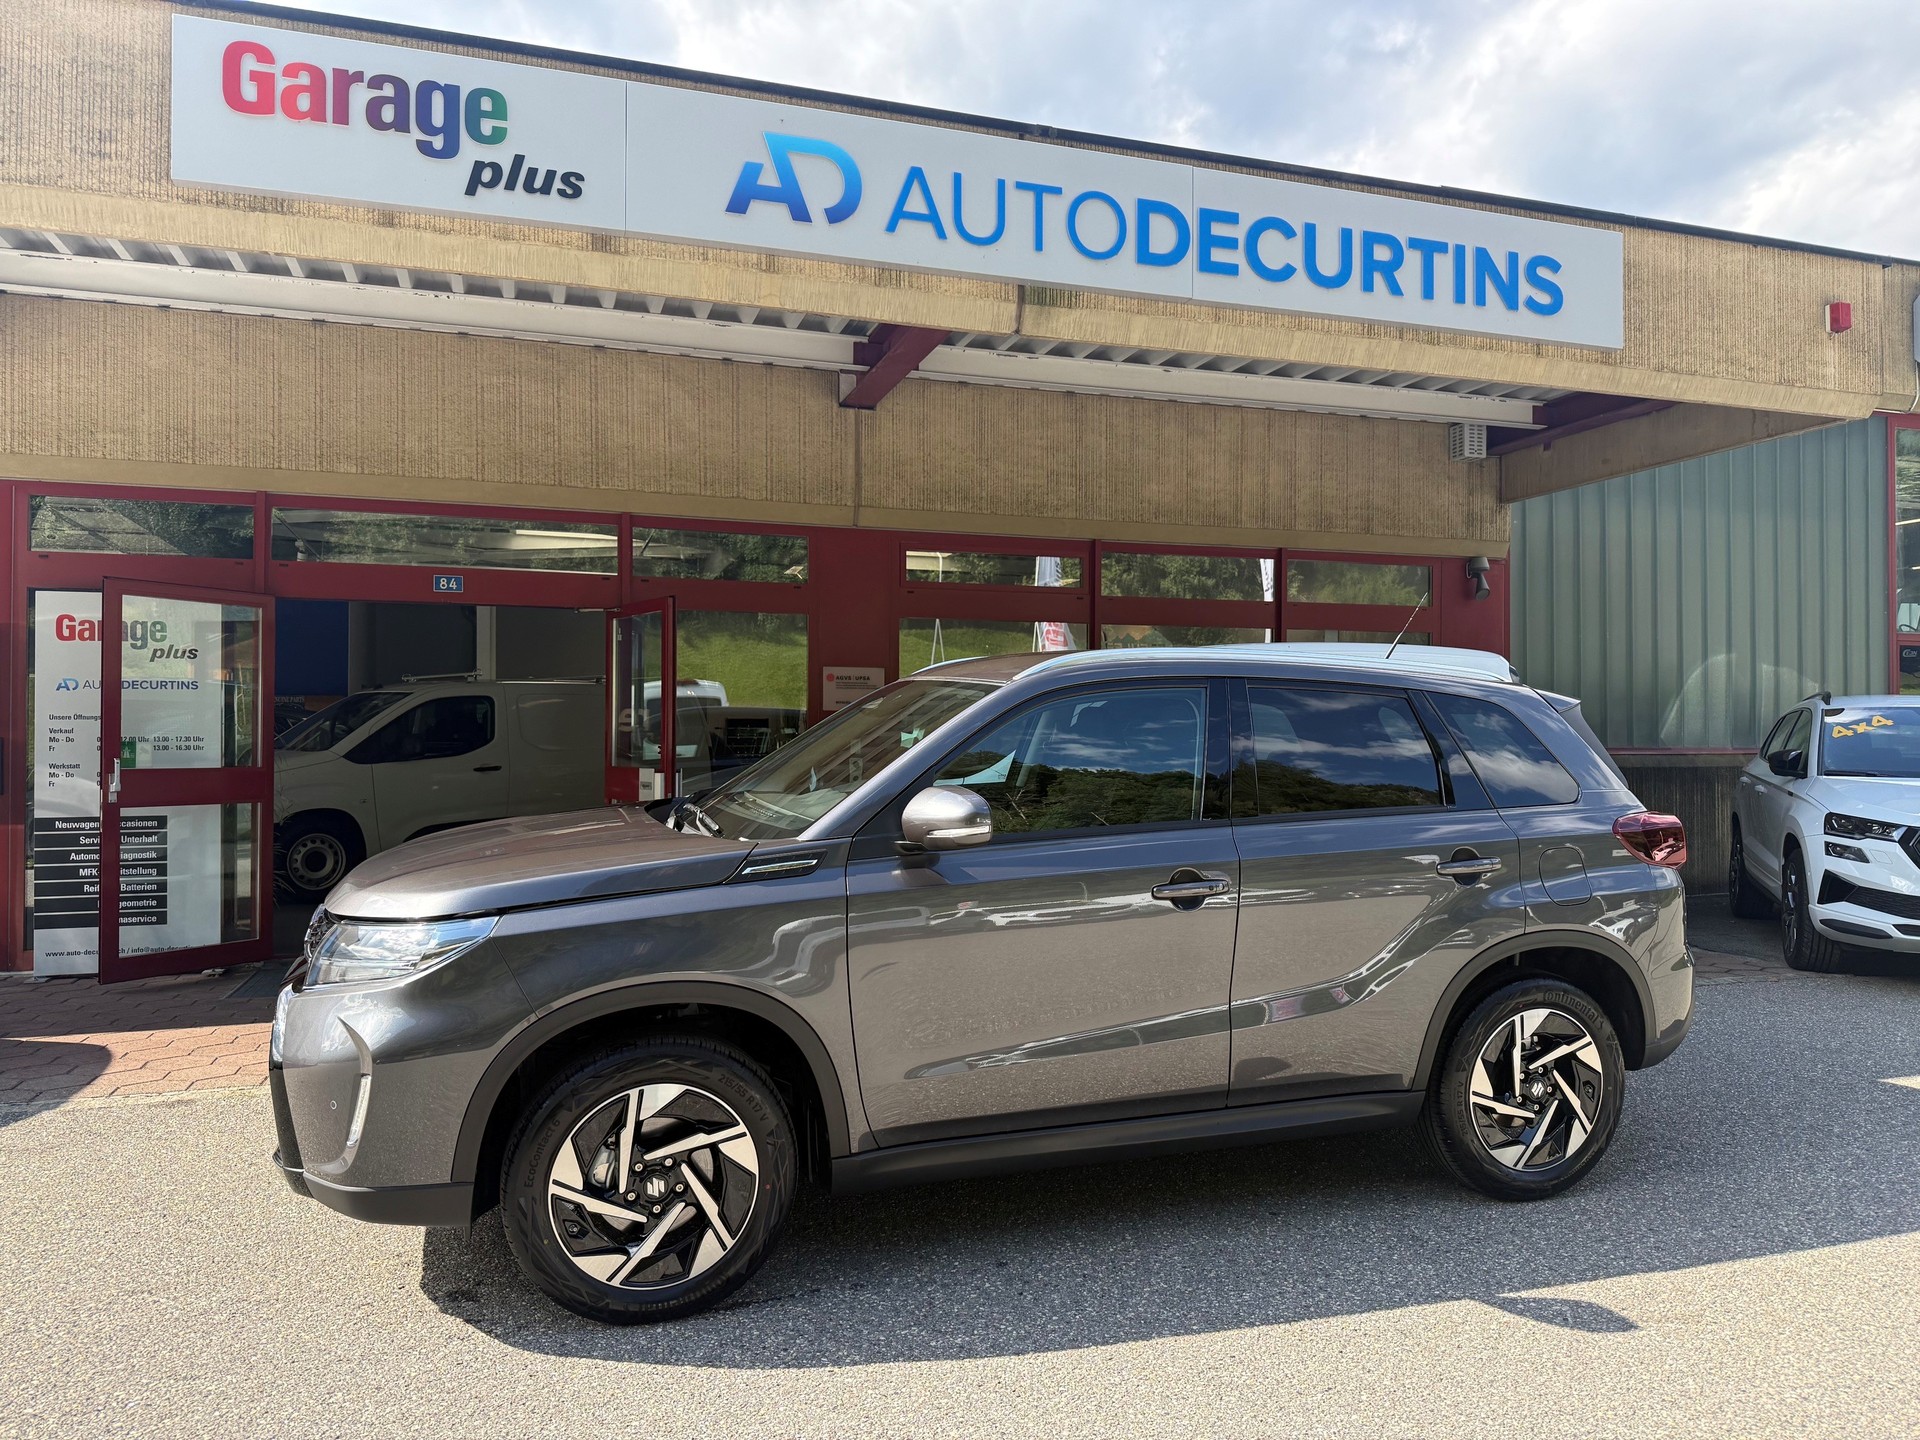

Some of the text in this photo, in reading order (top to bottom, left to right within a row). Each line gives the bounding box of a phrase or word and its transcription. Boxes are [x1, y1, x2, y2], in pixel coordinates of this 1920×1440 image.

[222, 41, 508, 160] Garage
[464, 154, 585, 199] plus
[885, 166, 1564, 316] AUTODECURTINS
[440, 577, 457, 590] 84
[149, 644, 199, 663] plus
[82, 679, 199, 690] AUDECURTINS
[48, 713, 72, 721] Unsere
[55, 820, 100, 830] Neuwagen
[80, 834, 158, 845] Servi Unterhalt
[83, 883, 157, 893] Reif Batterien
[718, 1073, 748, 1098] 215/55
[523, 1126, 556, 1188] EcoContact
